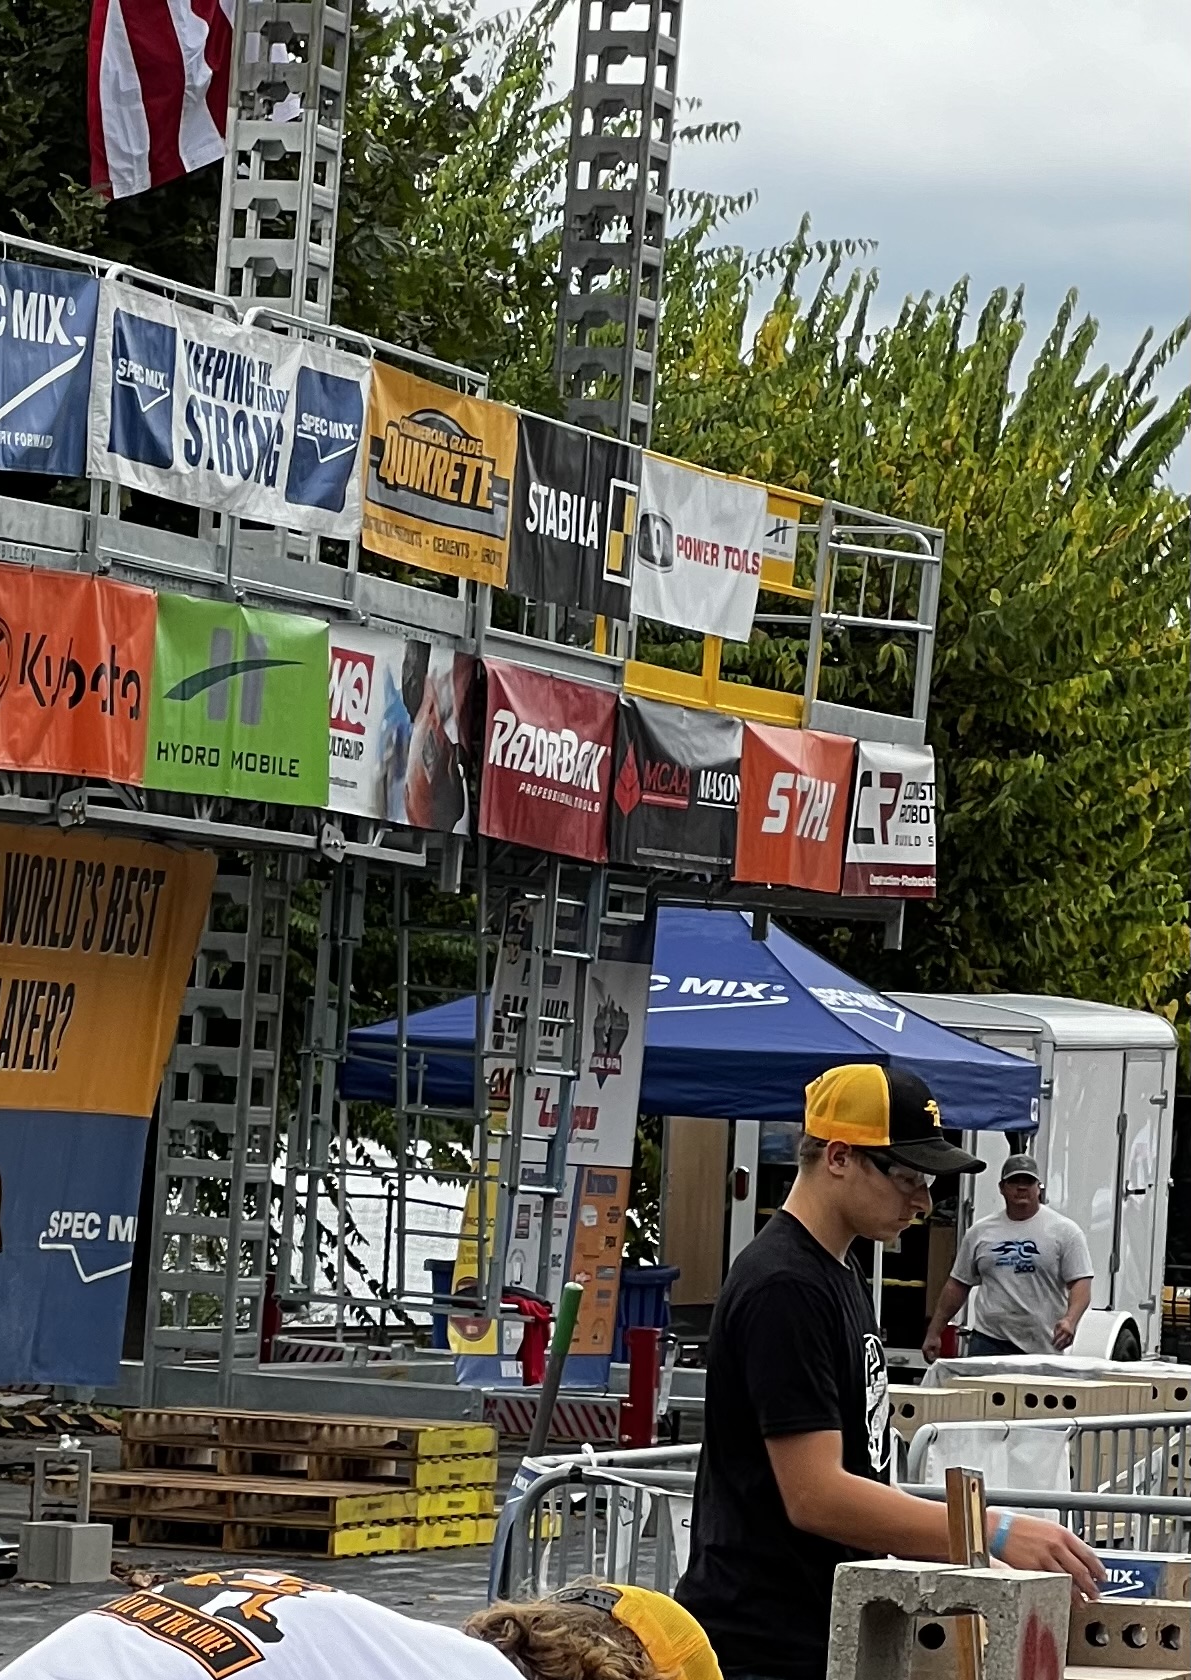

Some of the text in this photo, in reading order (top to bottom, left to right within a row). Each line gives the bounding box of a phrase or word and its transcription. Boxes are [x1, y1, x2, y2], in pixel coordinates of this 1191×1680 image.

[12, 289, 71, 346] MIX
[116, 357, 166, 391] SPEC MIX
[183, 339, 256, 408] KEEPING
[257, 386, 290, 414] TRAD
[184, 394, 284, 488] STRONG
[301, 412, 356, 441] SPEC MIX
[379, 425, 493, 509] QUIKRETE
[525, 481, 599, 549] STABILA
[676, 534, 720, 567] POWER
[20, 633, 142, 720] Kubota
[157, 741, 300, 778] HYDRO MOBILE
[330, 736, 364, 761] LTIQUIP
[643, 759, 691, 793] MCAA
[761, 771, 837, 841] STIHL
[0, 851, 106, 952] WORLD'S
[99, 864, 166, 958] BEST
[679, 977, 771, 999] MIX
[48, 1210, 101, 1240] SPEC
[153, 1611, 200, 1636] THE
[181, 1623, 237, 1657] LINE!
